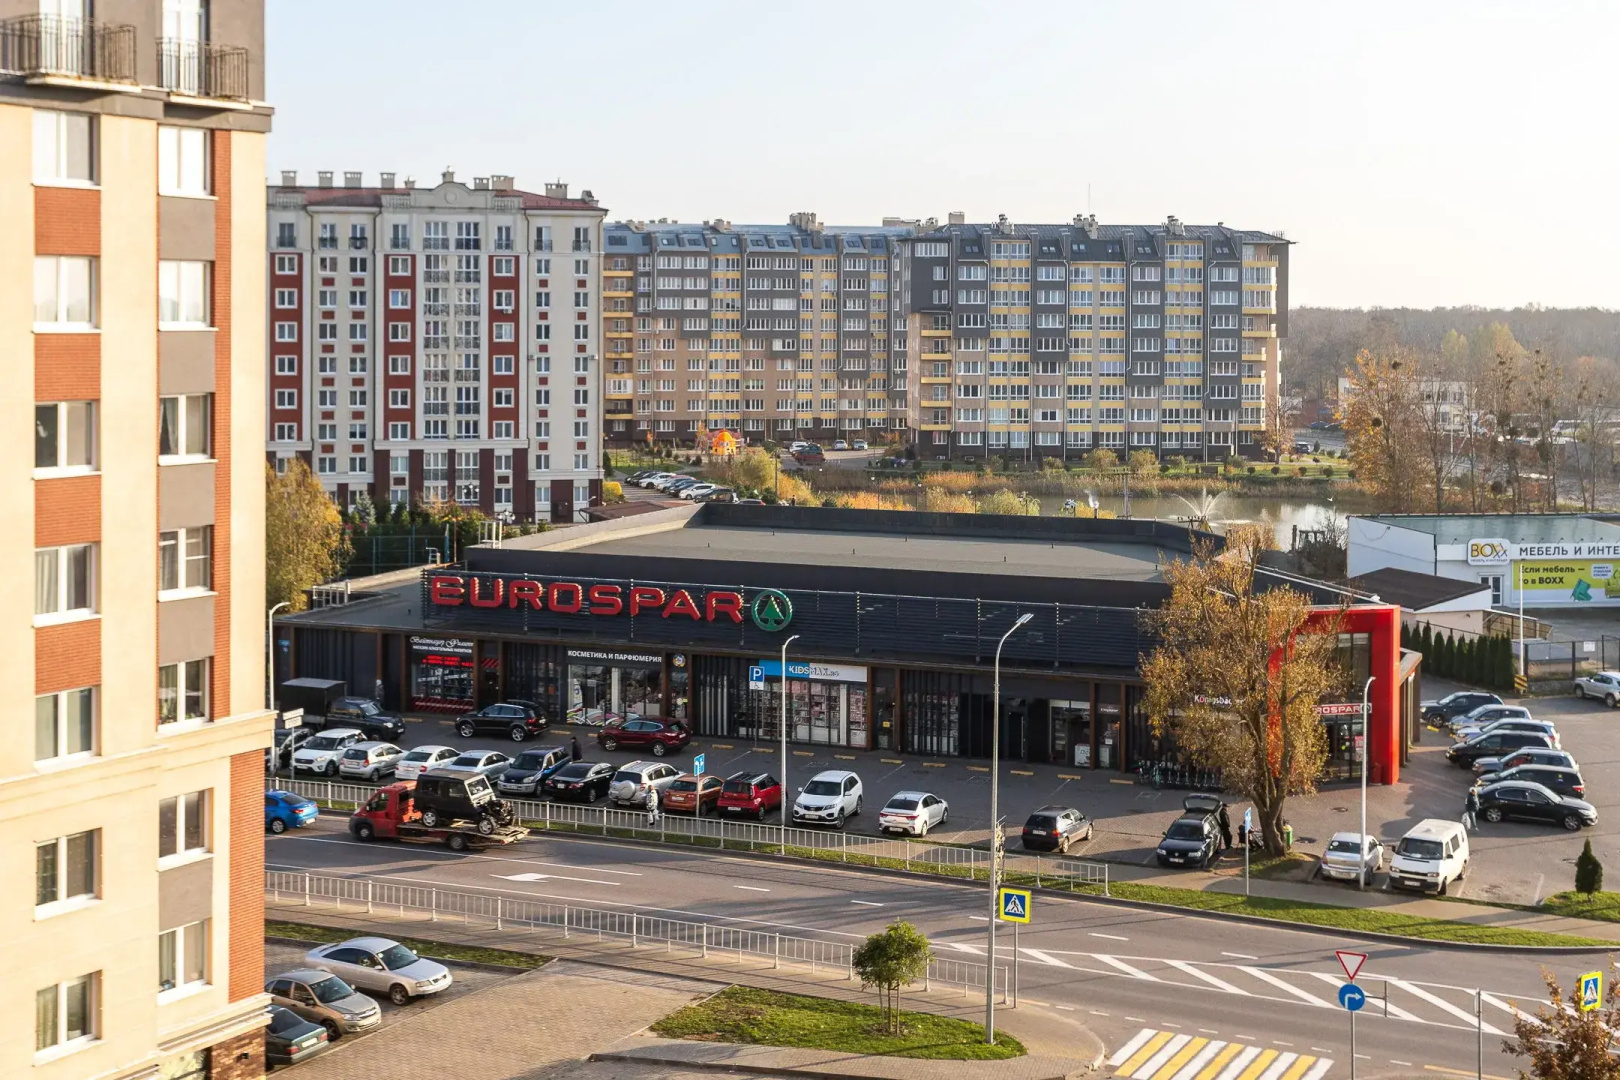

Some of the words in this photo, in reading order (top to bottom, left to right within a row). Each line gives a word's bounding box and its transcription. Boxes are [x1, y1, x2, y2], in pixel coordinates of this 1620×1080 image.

[1471, 543, 1508, 559] BOXX
[1520, 546, 1568, 556] МЕБЕЛЬ
[1574, 546, 1582, 556] И
[1588, 545, 1620, 555] ИНТЕ
[1519, 566, 1540, 574] Если
[431, 576, 744, 622] EUROSPAR
[567, 651, 607, 659] КОСМЕТИКА
[614, 653, 662, 663] ПАРФЮМЕРИЯ
[753, 668, 761, 681] P
